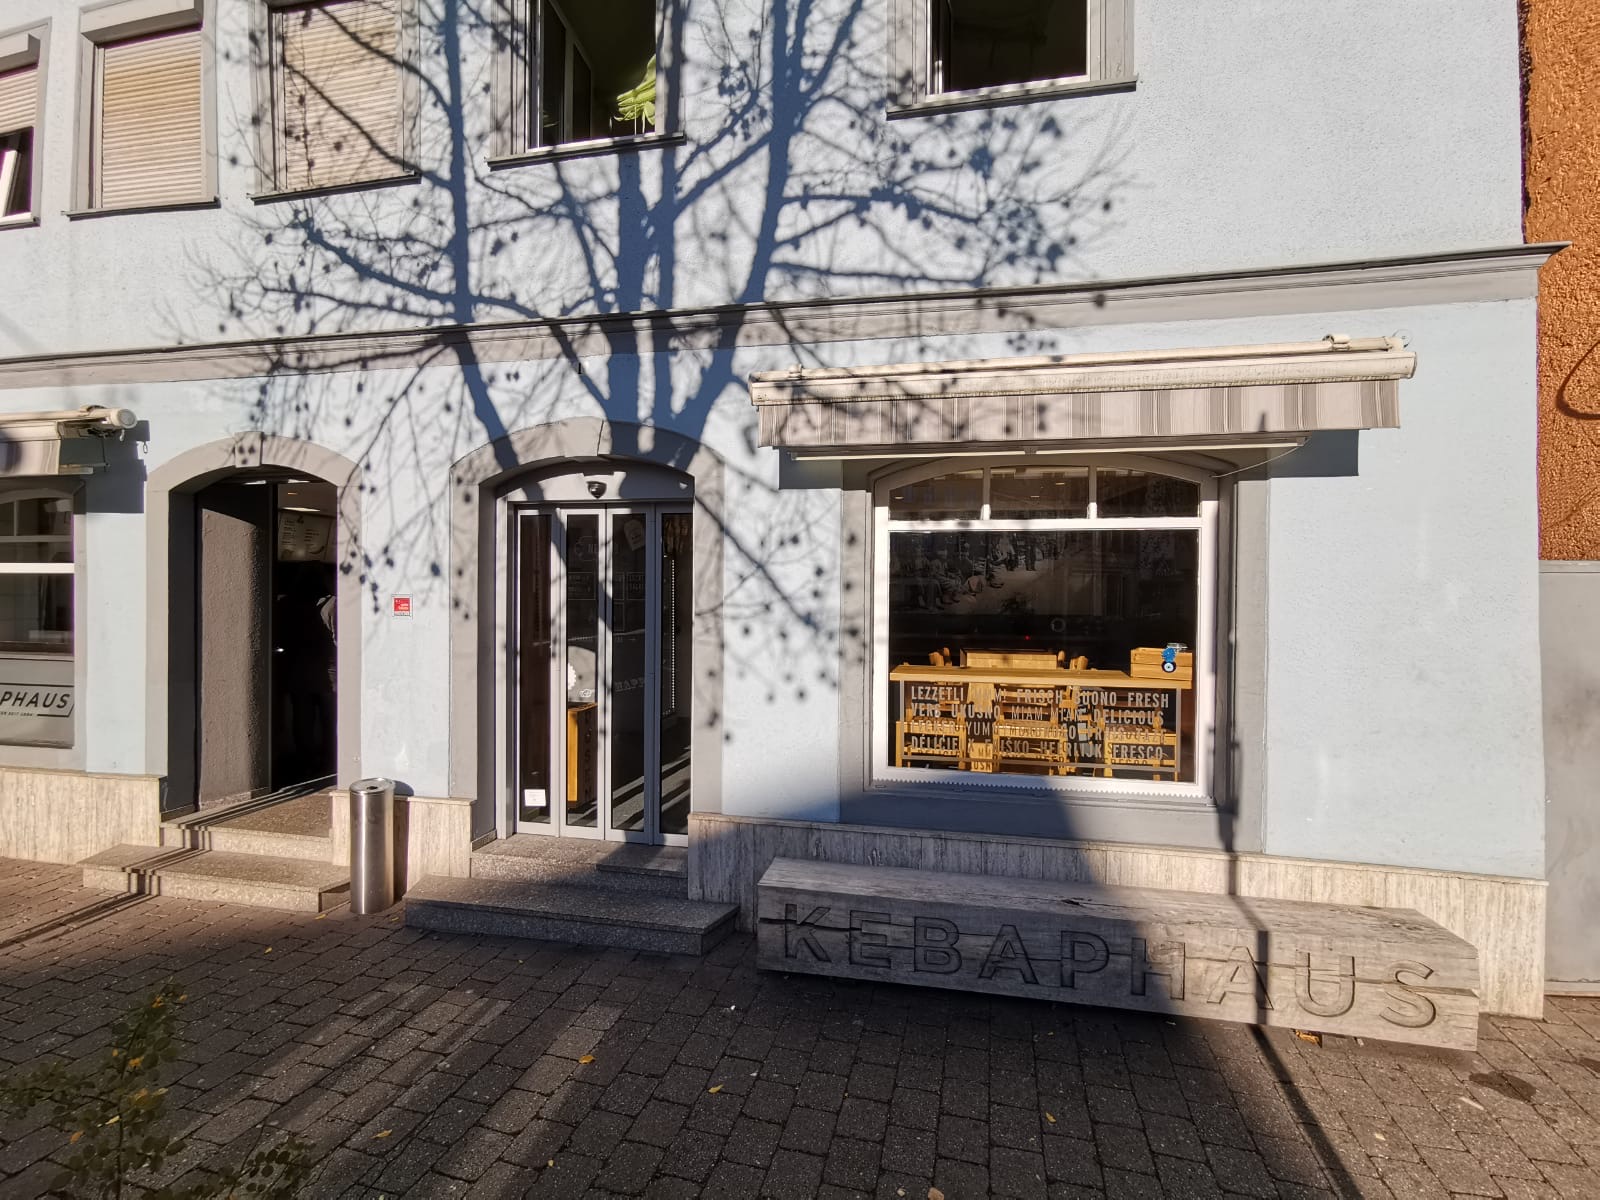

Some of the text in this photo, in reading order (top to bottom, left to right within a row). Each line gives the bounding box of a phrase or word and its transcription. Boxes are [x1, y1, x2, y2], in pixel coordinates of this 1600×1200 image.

[911, 686, 964, 702] LEZZETLI
[1016, 688, 1063, 705] FRISCH
[1127, 692, 1169, 708] FRESH
[1094, 708, 1164, 726] DELICIOUS
[911, 734, 976, 753] DÉLICIEX
[1112, 744, 1163, 761] FRESCO
[784, 903, 1437, 1030] KEBAPHAUS
